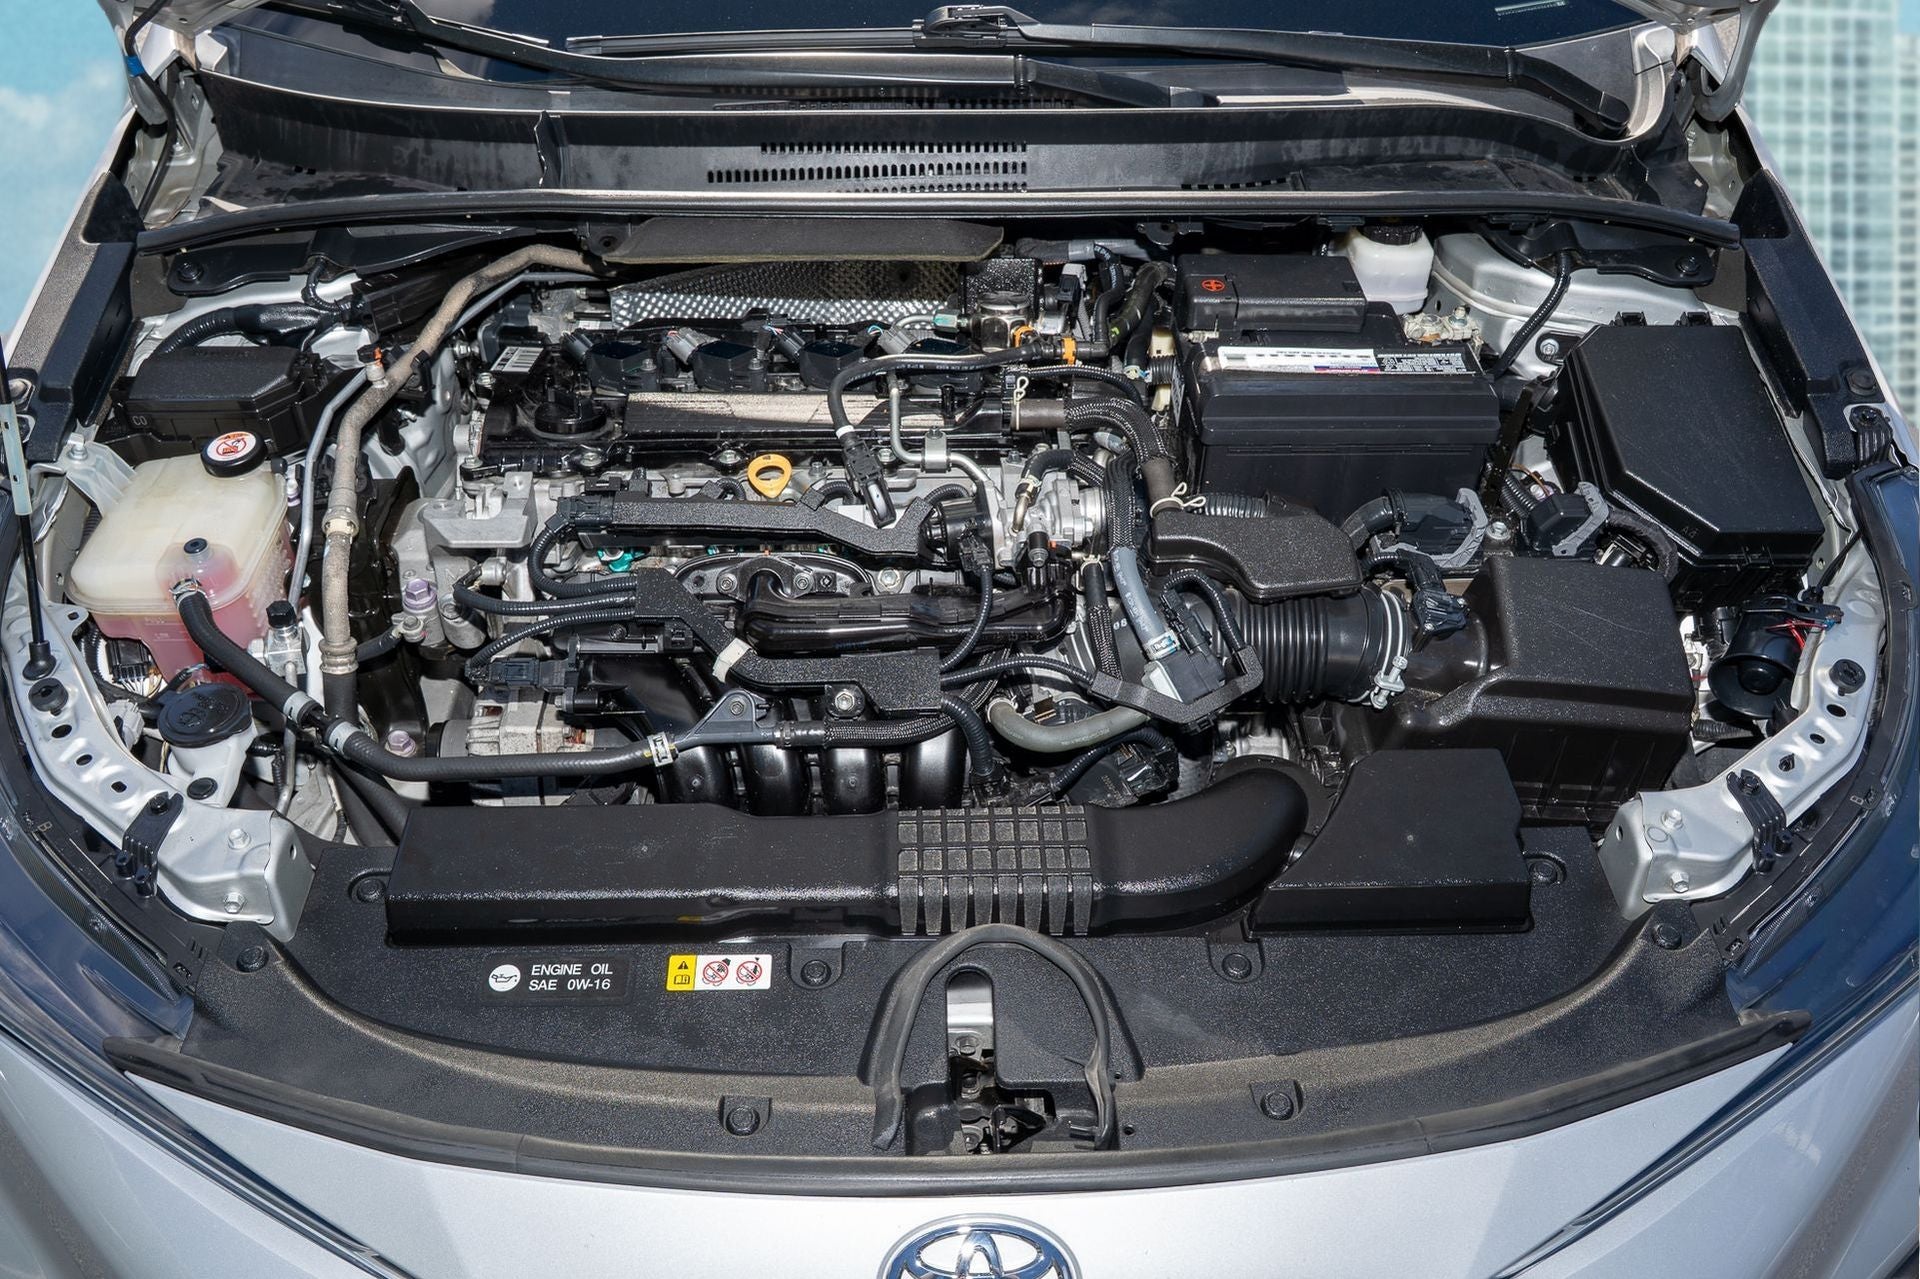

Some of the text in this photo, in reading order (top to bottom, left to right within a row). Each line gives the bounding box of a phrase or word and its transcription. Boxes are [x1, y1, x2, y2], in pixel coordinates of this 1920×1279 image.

[531, 963, 613, 976] ENGINE OIL
[528, 978, 611, 991] SAE 0W-16
